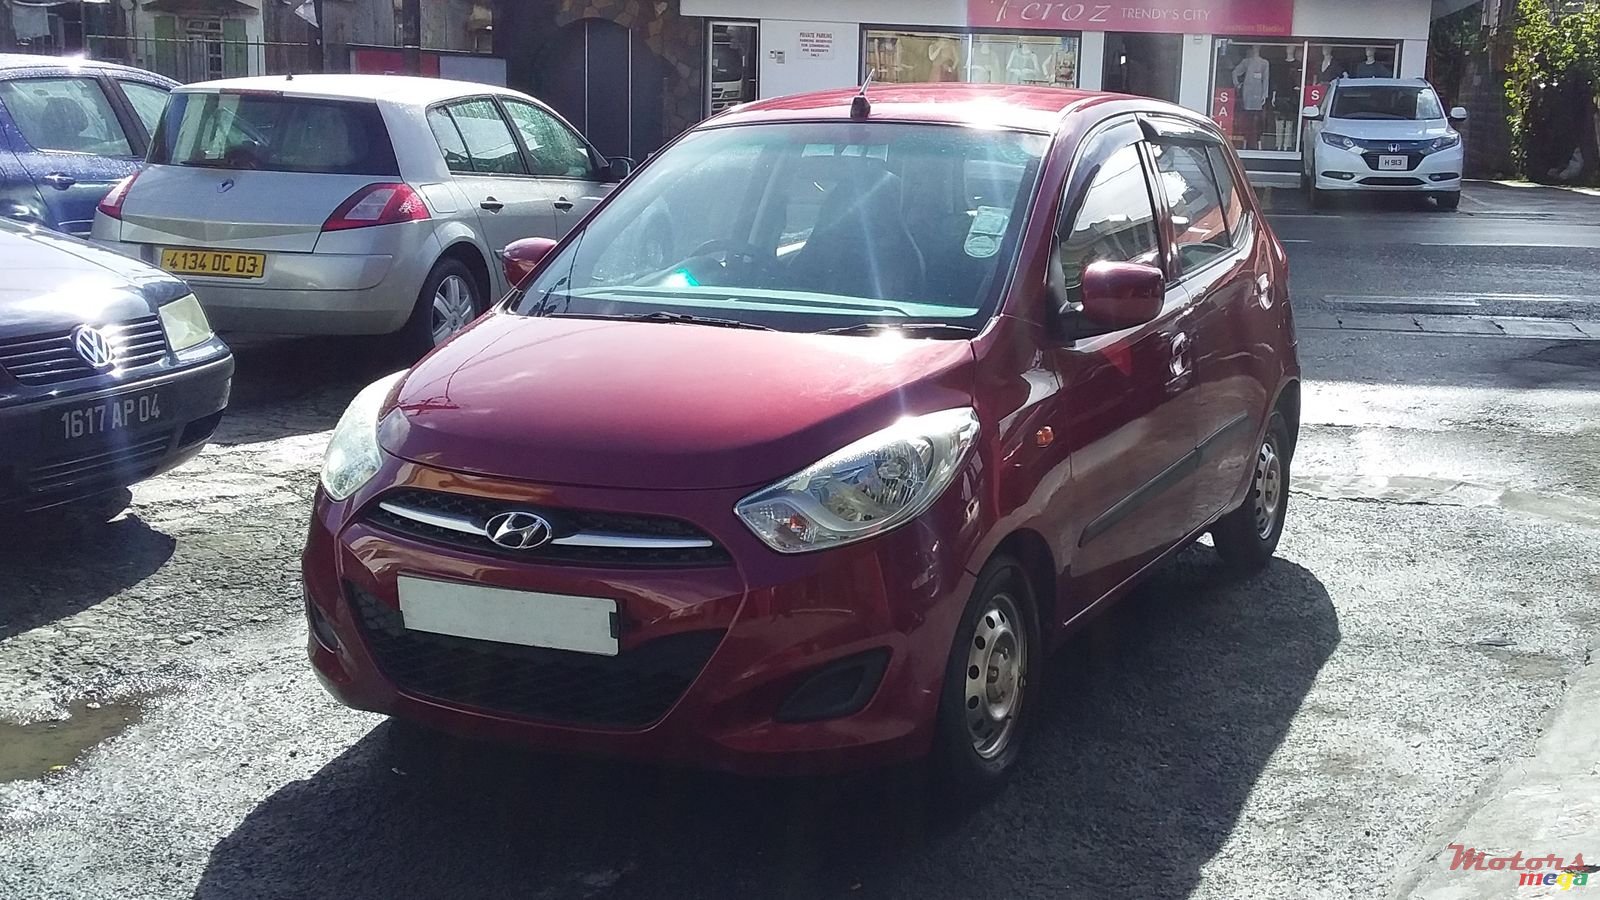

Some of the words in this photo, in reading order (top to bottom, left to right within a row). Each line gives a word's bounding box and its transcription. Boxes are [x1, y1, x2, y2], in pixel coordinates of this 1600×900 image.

[1121, 7, 1180, 20] TRENDY'S
[1183, 9, 1212, 21] CITY
[169, 252, 207, 270] 4134
[212, 254, 232, 272] DC
[236, 255, 258, 273] 03
[61, 405, 106, 439] 1617
[112, 400, 135, 429] AP
[139, 393, 160, 422] 04
